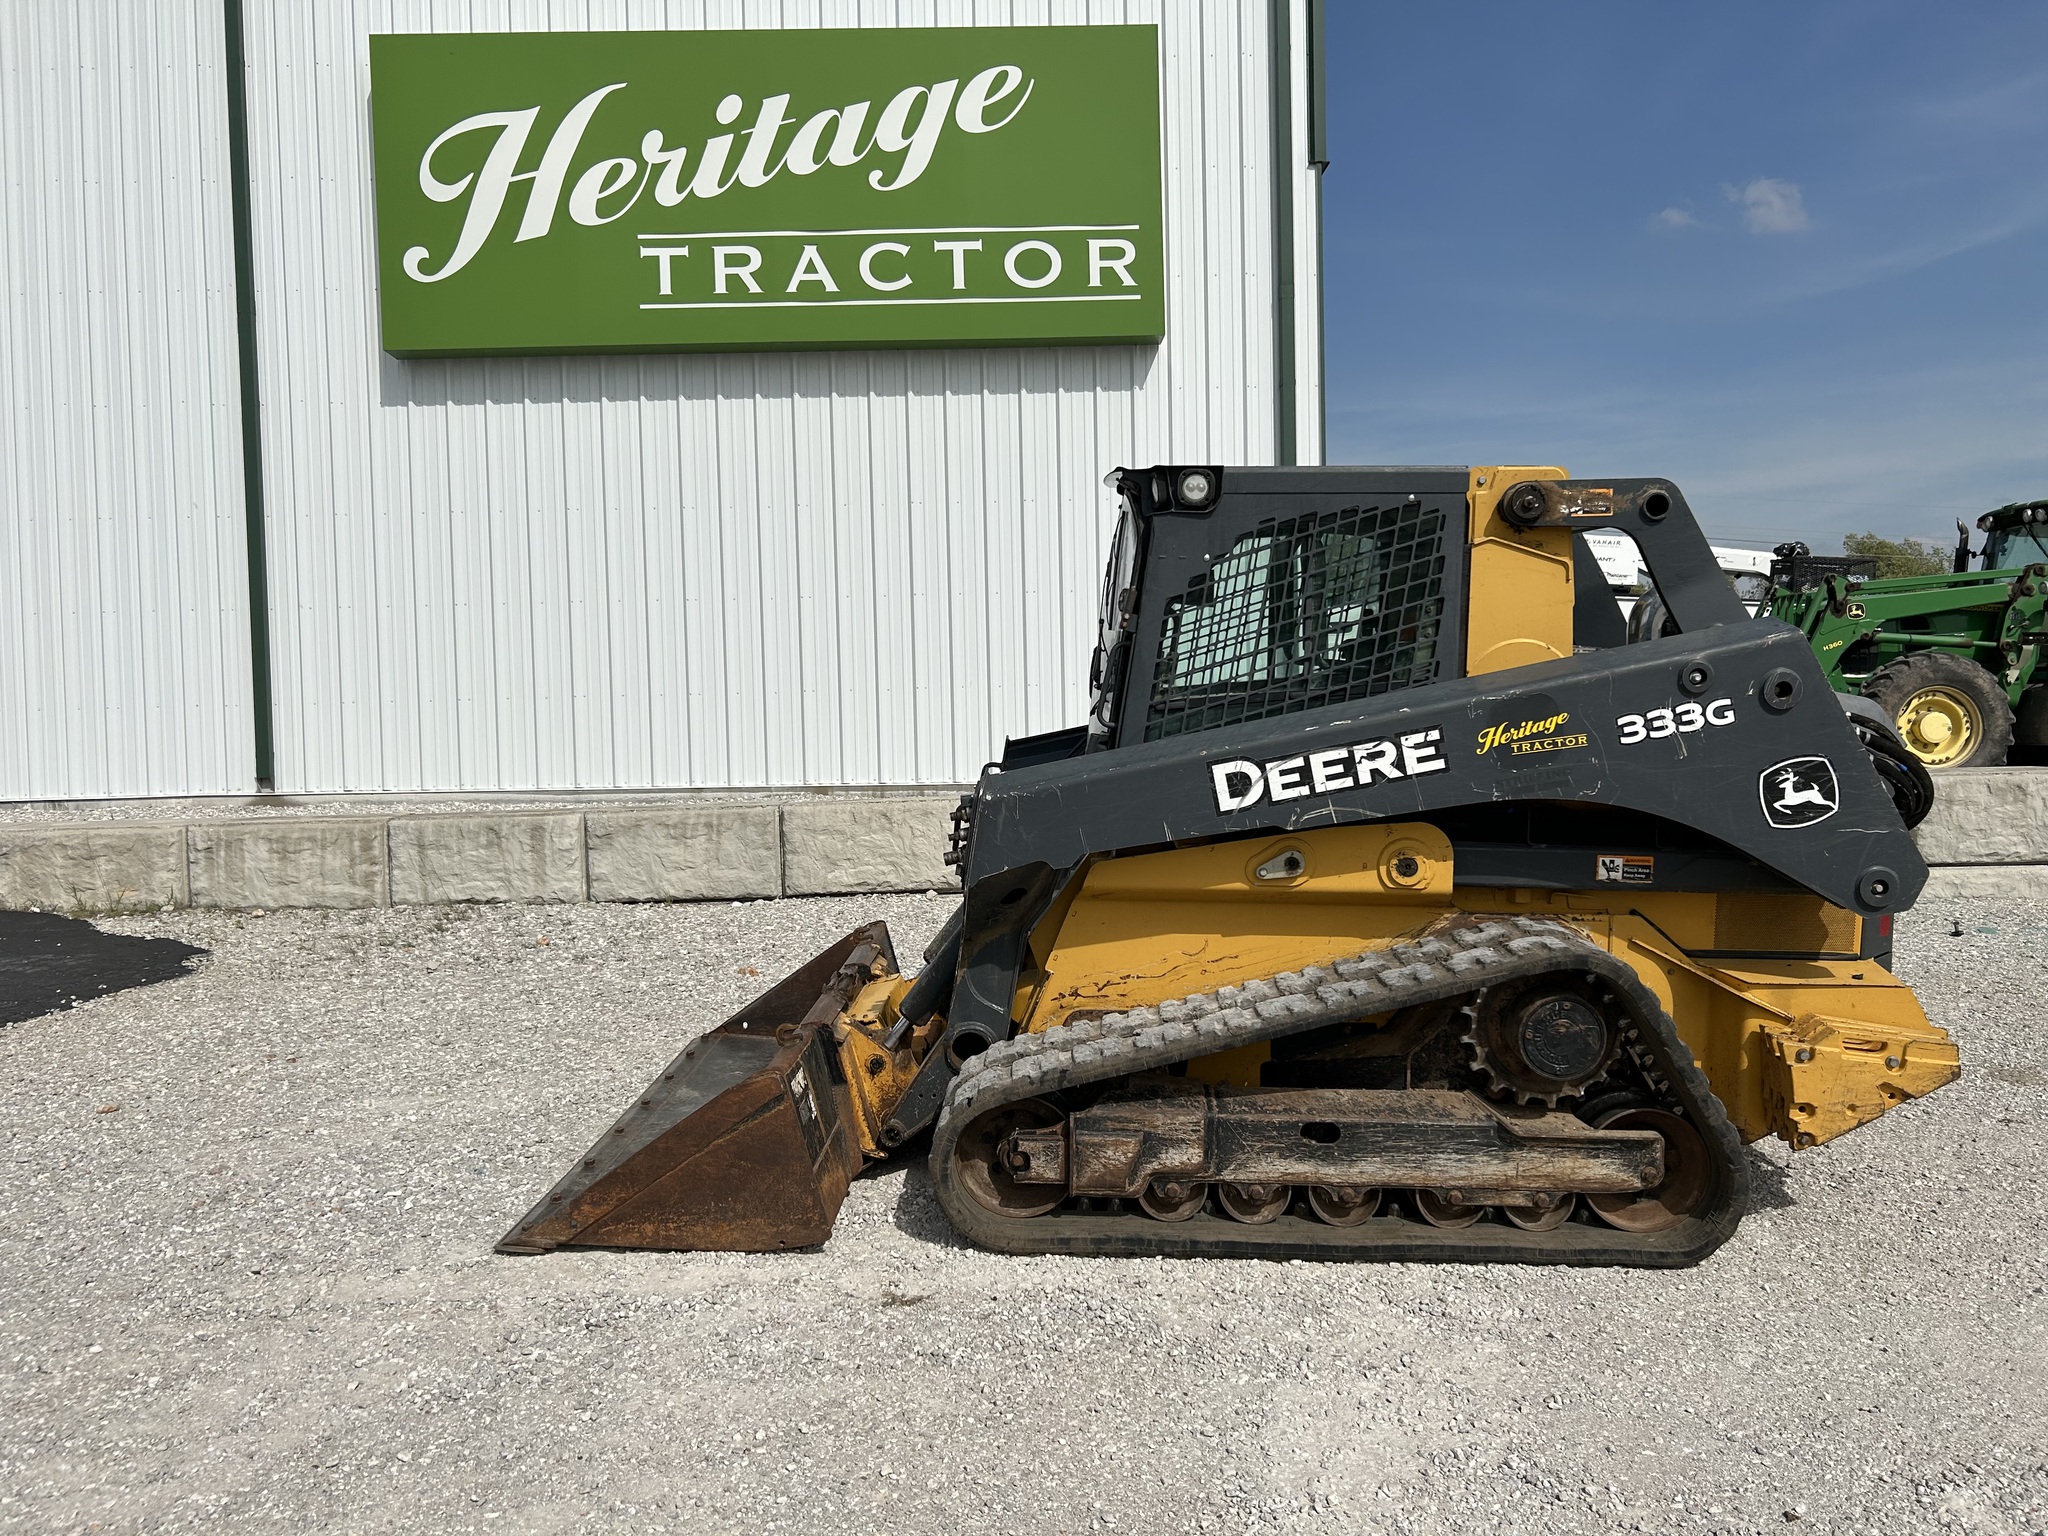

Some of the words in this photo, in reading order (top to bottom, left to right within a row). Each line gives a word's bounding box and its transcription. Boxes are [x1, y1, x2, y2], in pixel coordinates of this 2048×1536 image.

[403, 65, 1034, 283] Heritage
[639, 238, 1139, 296] TRACTOR
[1823, 640, 1843, 651] H360
[1476, 712, 1570, 755] Heritage
[1511, 735, 1588, 753] TRACTOR
[1617, 698, 1736, 745] 333G
[1211, 729, 1446, 812] DEERE
